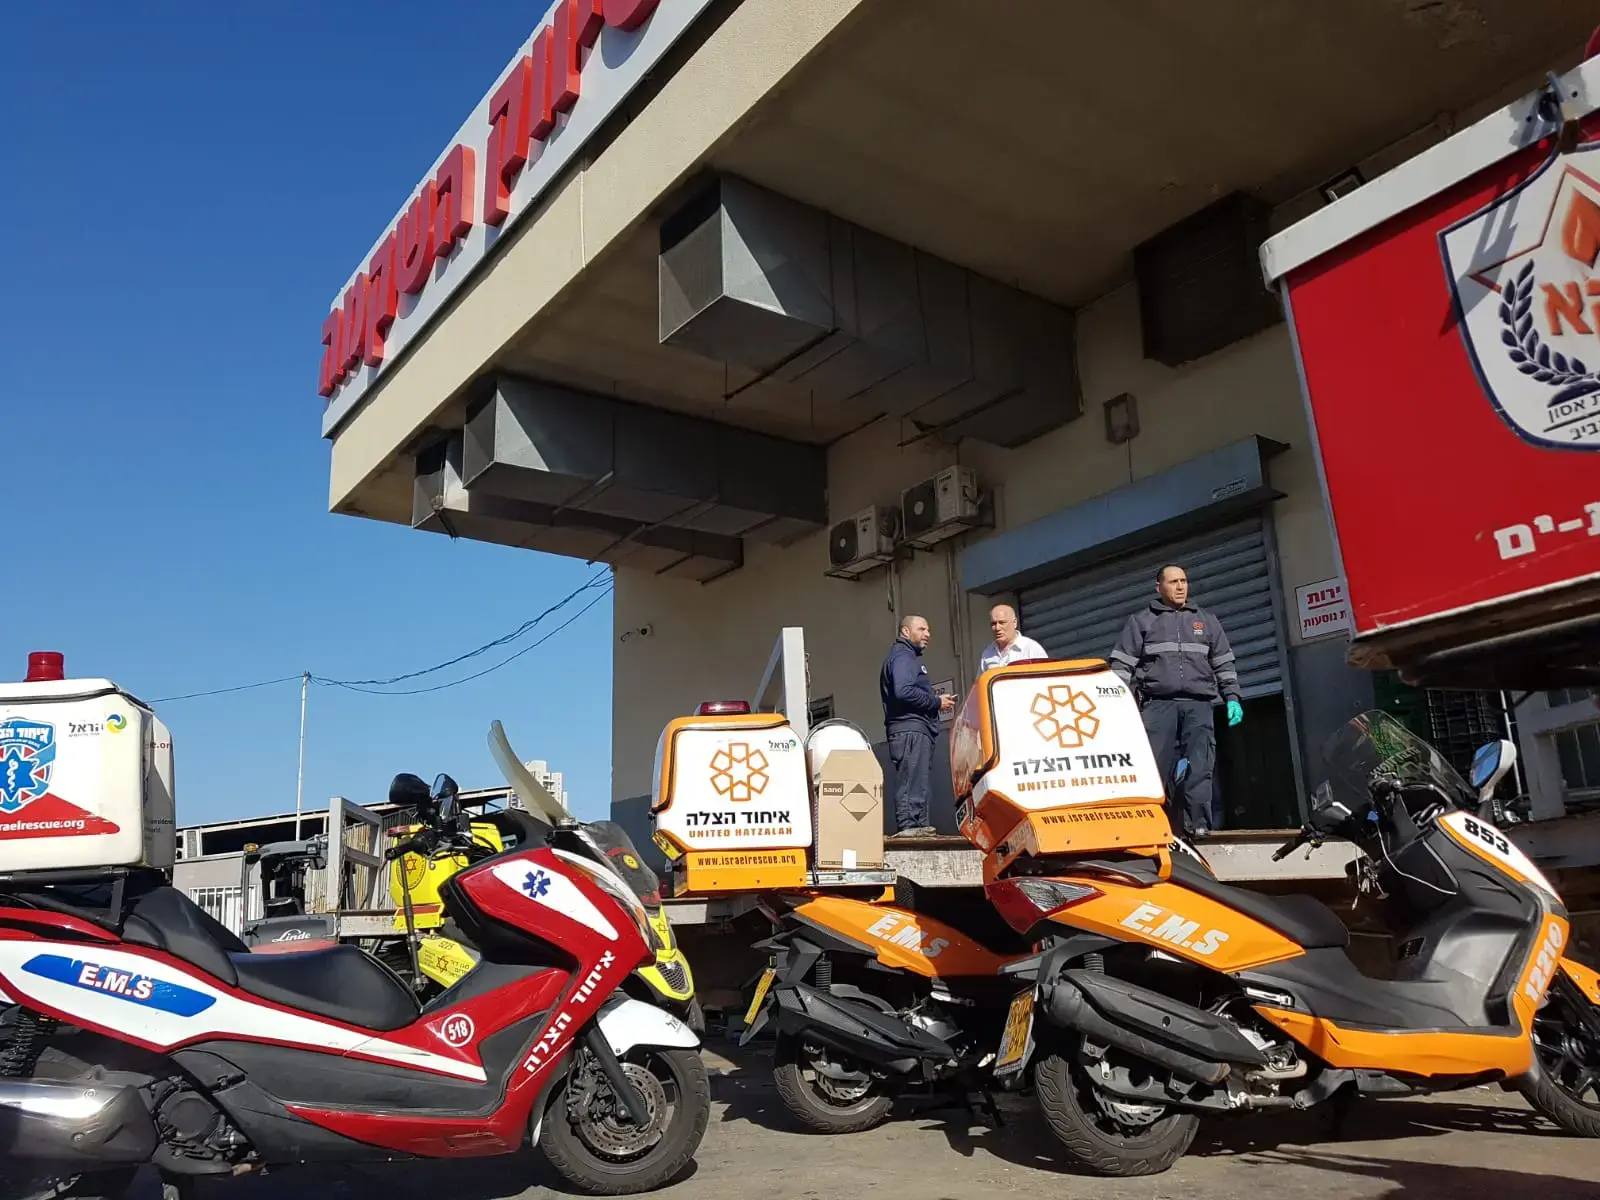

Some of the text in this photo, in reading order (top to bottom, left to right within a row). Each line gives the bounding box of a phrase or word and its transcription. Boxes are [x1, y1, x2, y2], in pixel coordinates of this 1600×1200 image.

[317, 143, 475, 397] השקמה
[1548, 399, 1586, 424] אסון
[769, 740, 790, 752] הראל
[1012, 753, 1135, 776] איחוד הצלה
[1017, 774, 1138, 792] UNITED HATZALAH
[686, 810, 791, 826] איחוד הצלה
[1041, 808, 1155, 825] www.israelrescue.org
[689, 827, 793, 838] UNITED HATZALAH
[1463, 817, 1510, 856] 853
[697, 854, 797, 866] www.israelrescue.org
[271, 929, 312, 943] Linde
[866, 914, 950, 958] E.M.S
[1119, 901, 1230, 956] E.M.S
[78, 963, 154, 999] E.M.S
[523, 950, 616, 1073] איחוד הצלה
[448, 1021, 468, 1041] 518
